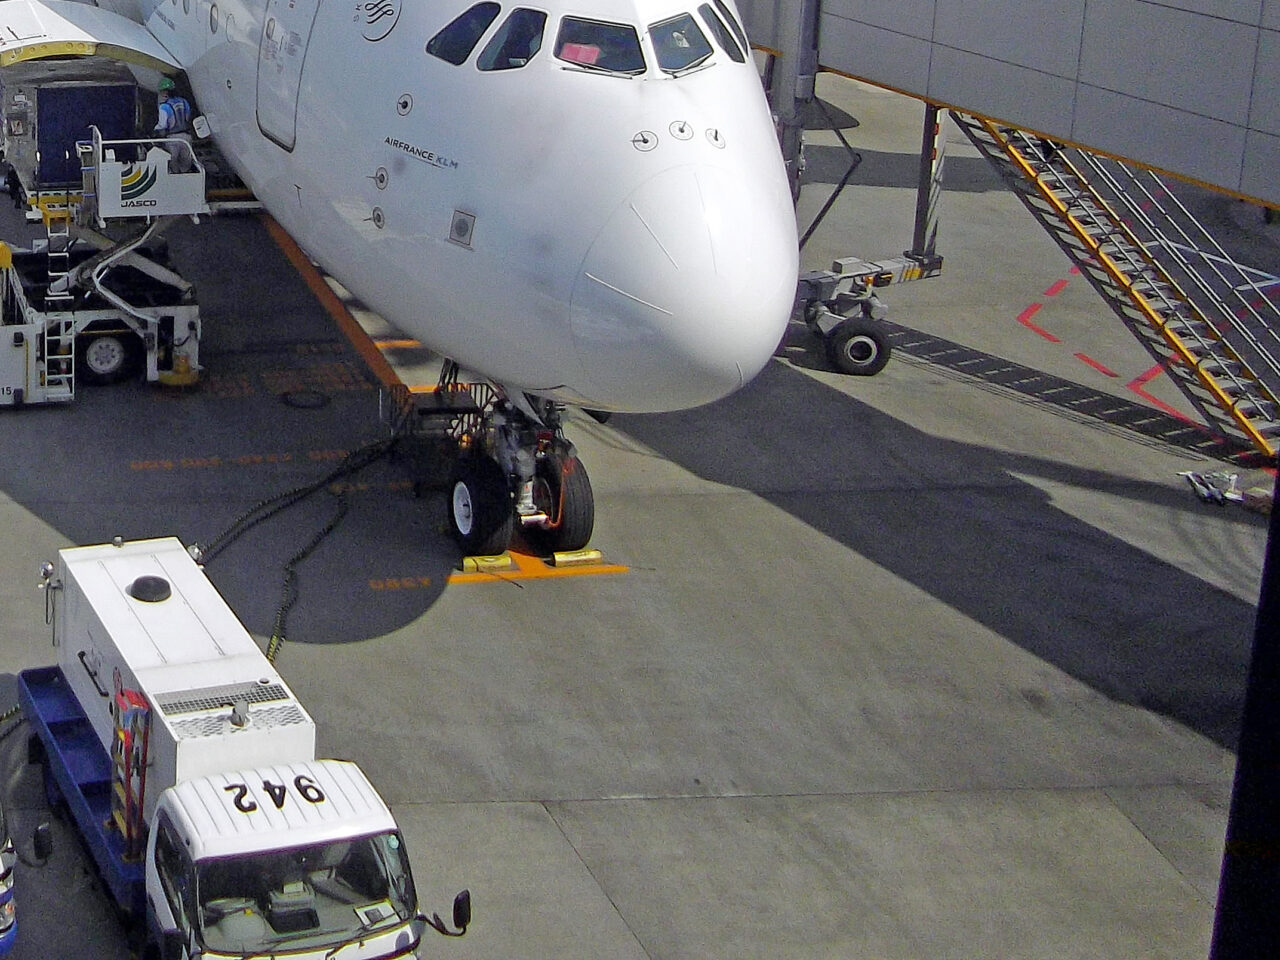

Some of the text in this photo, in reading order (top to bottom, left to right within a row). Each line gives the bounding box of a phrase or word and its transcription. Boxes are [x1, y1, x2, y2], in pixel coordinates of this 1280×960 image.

[384, 136, 458, 169] AIRFRANCE KLM
[223, 775, 325, 813] 942
